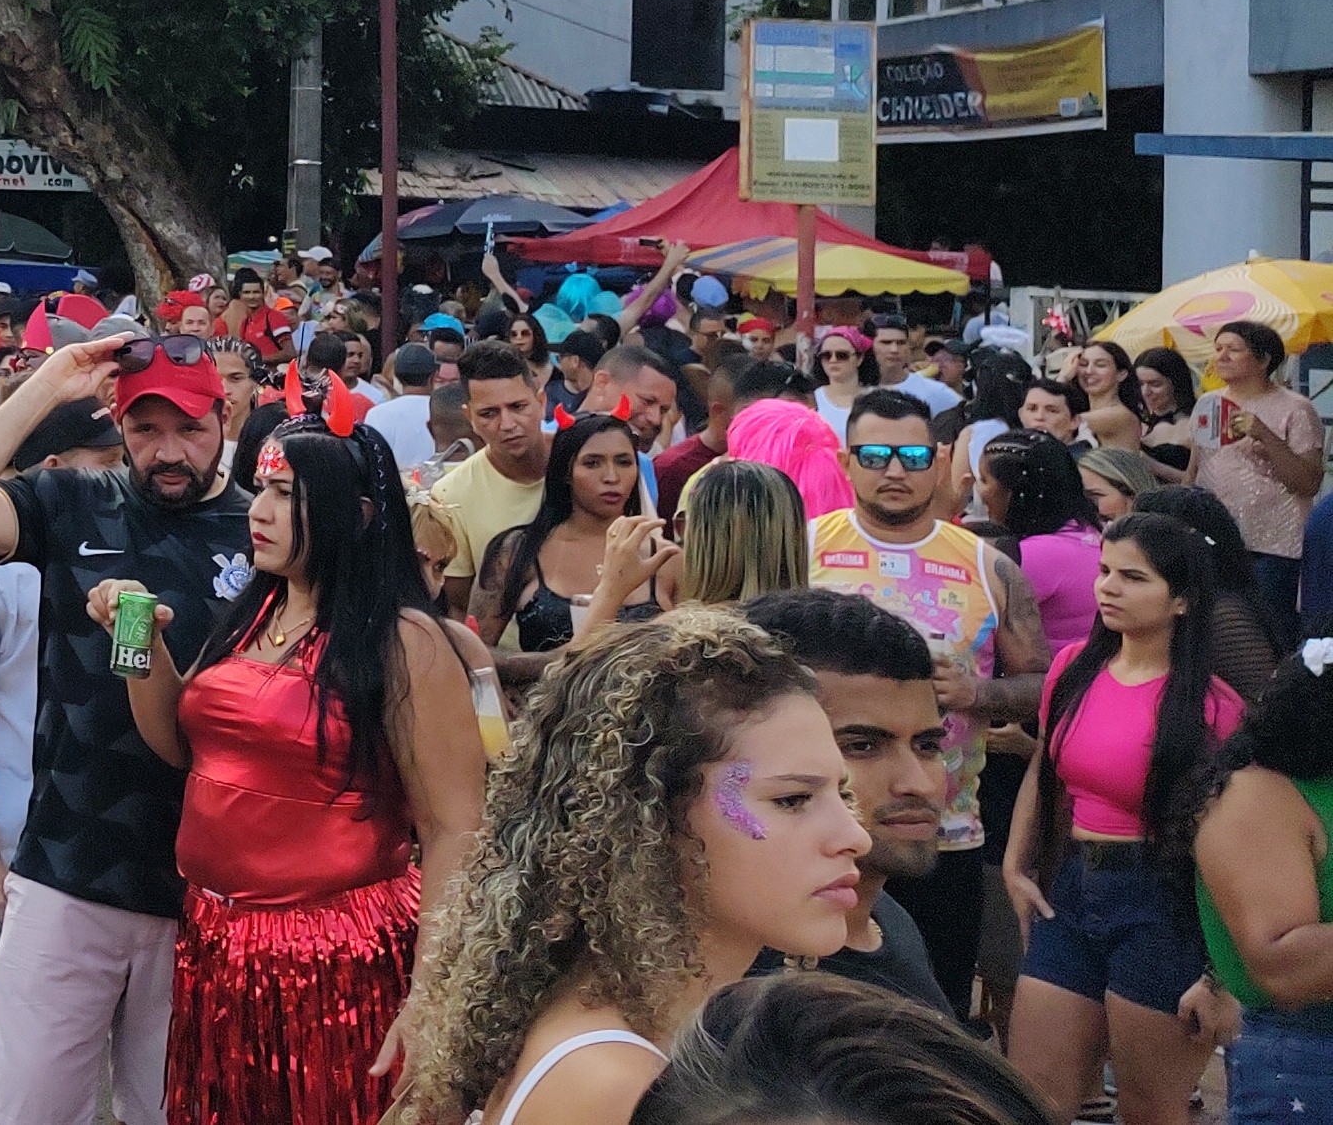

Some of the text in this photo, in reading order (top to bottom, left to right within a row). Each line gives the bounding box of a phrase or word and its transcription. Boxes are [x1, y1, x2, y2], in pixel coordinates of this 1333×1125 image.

[886, 57, 944, 85] COLEÇÃO
[43, 177, 73, 188] .com
[924, 561, 967, 582] BRAHMA
